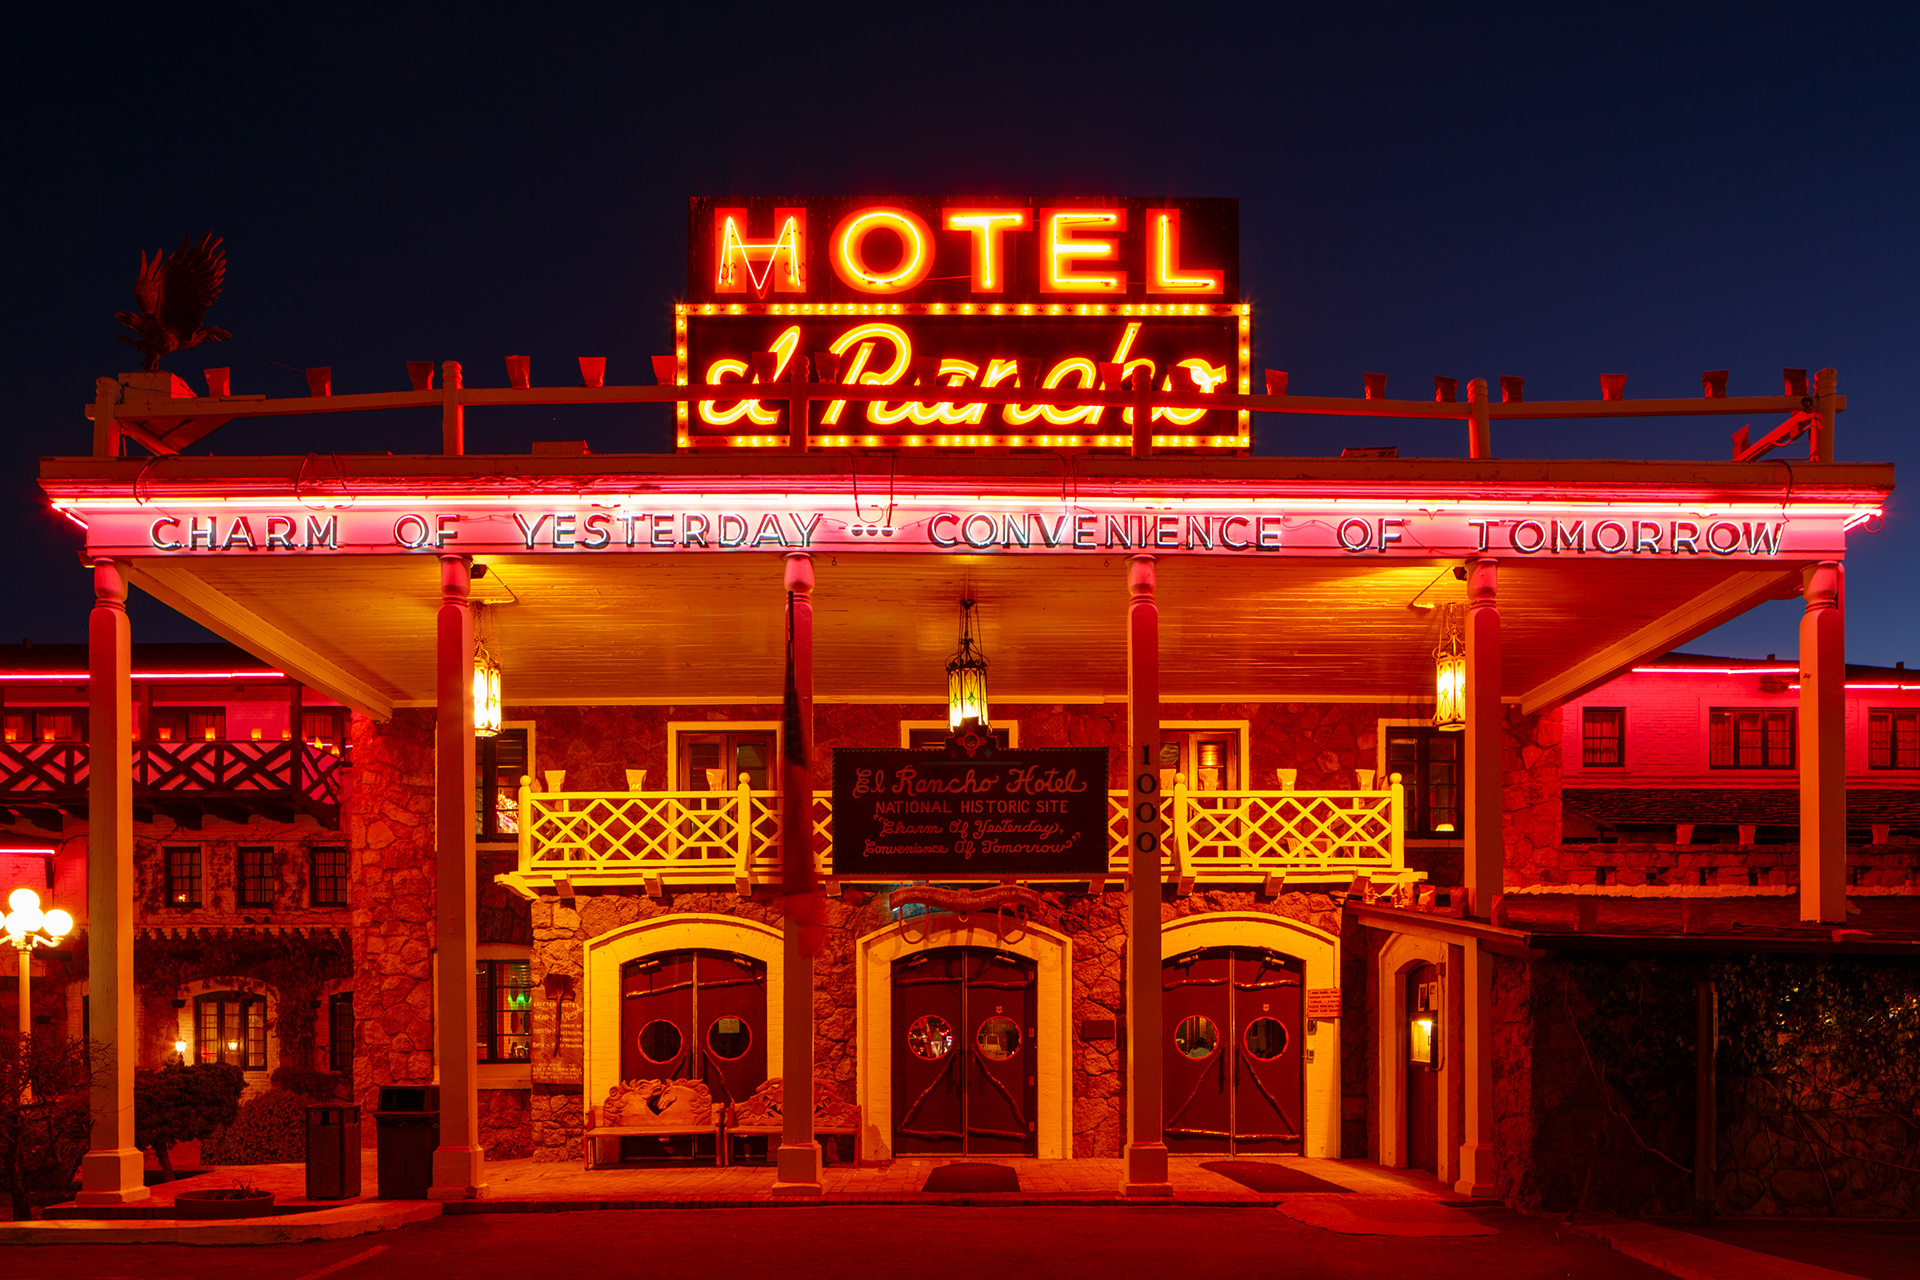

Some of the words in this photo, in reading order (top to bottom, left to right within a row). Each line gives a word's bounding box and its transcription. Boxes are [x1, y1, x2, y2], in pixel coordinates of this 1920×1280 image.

[714, 207, 1224, 298] HOTEL
[820, 322, 1227, 426] Rancho
[149, 514, 338, 551] CHARM
[393, 513, 461, 550] OF
[513, 512, 820, 549] YESTERDAY
[927, 512, 1283, 552] CONVENIENCE
[1338, 517, 1403, 553] OF
[1468, 518, 1785, 556] TOMORROW
[852, 767, 886, 799] El
[891, 764, 1000, 797] Rancho
[1005, 764, 1087, 795] Hotel
[1135, 744, 1157, 853] 1000
[875, 800, 952, 814] NATIONAL
[961, 800, 1030, 814] HISTORIC
[1035, 800, 1069, 814] SITE
[949, 818, 969, 839] Of
[954, 838, 976, 860] Of
